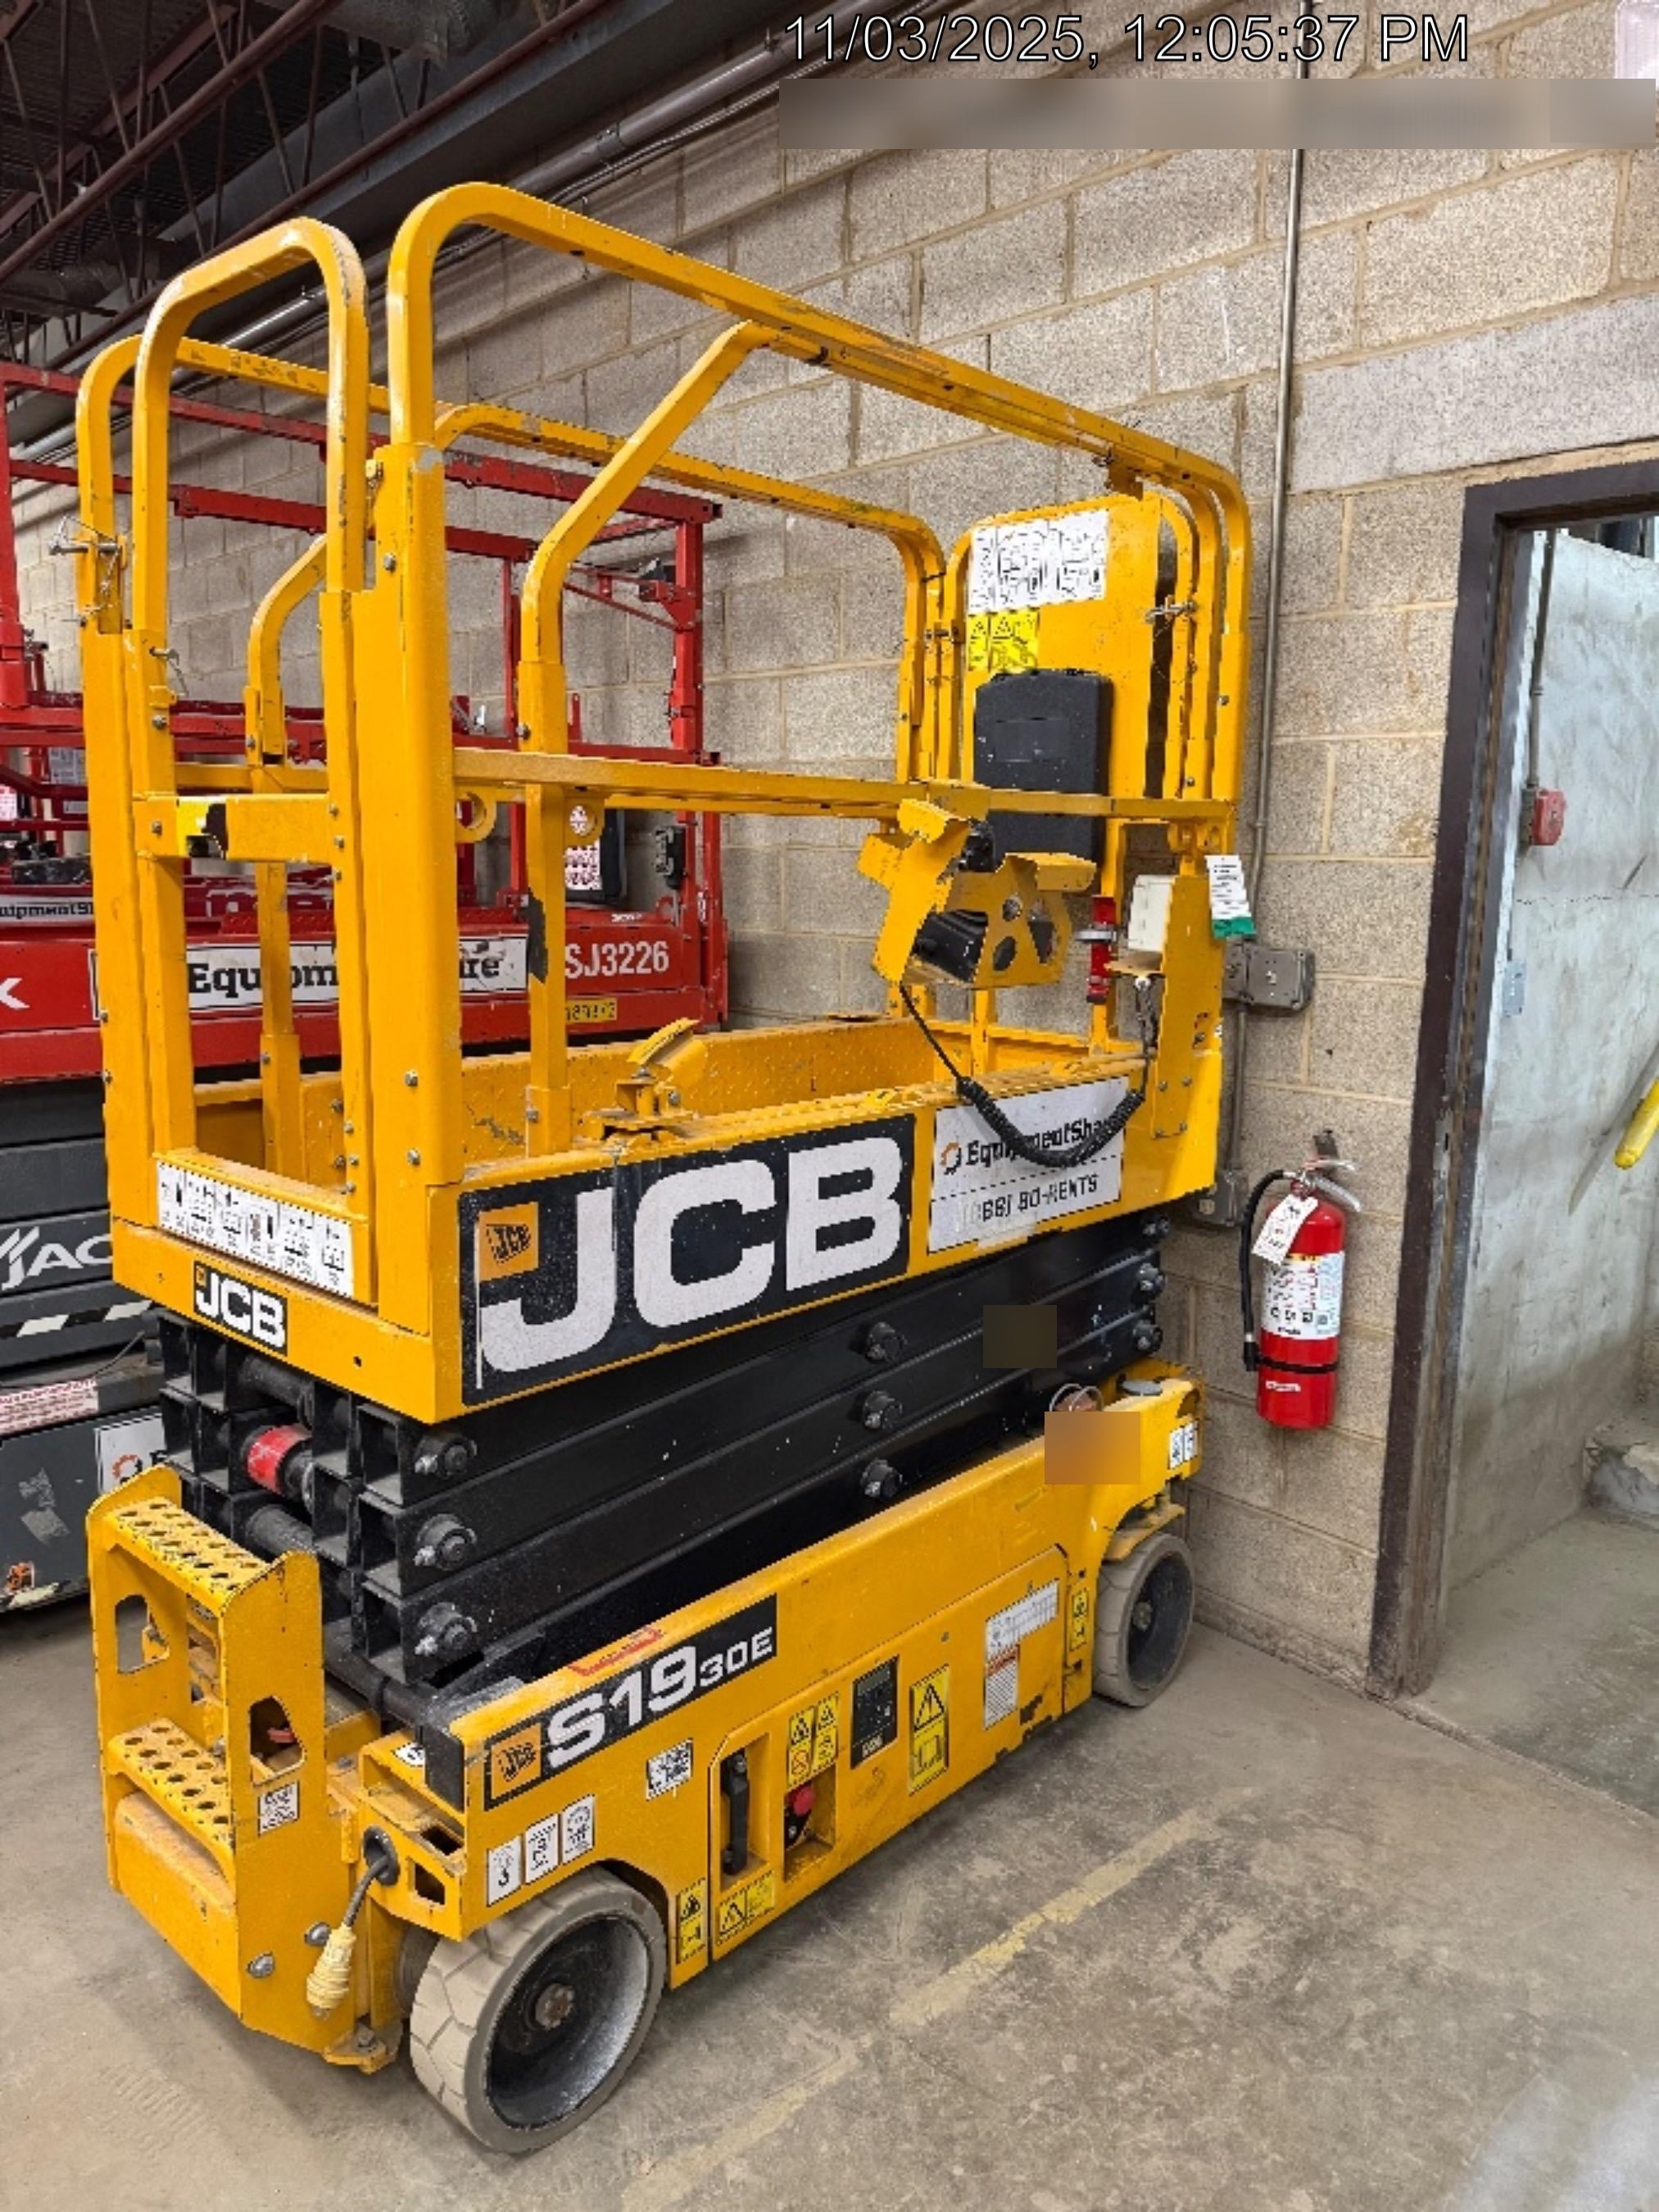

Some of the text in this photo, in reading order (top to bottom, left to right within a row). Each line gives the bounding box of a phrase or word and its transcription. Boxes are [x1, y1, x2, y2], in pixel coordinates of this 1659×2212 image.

[564, 941, 670, 979] SJ3226
[480, 1136, 902, 1373] JCB
[196, 1271, 286, 1348] JCB
